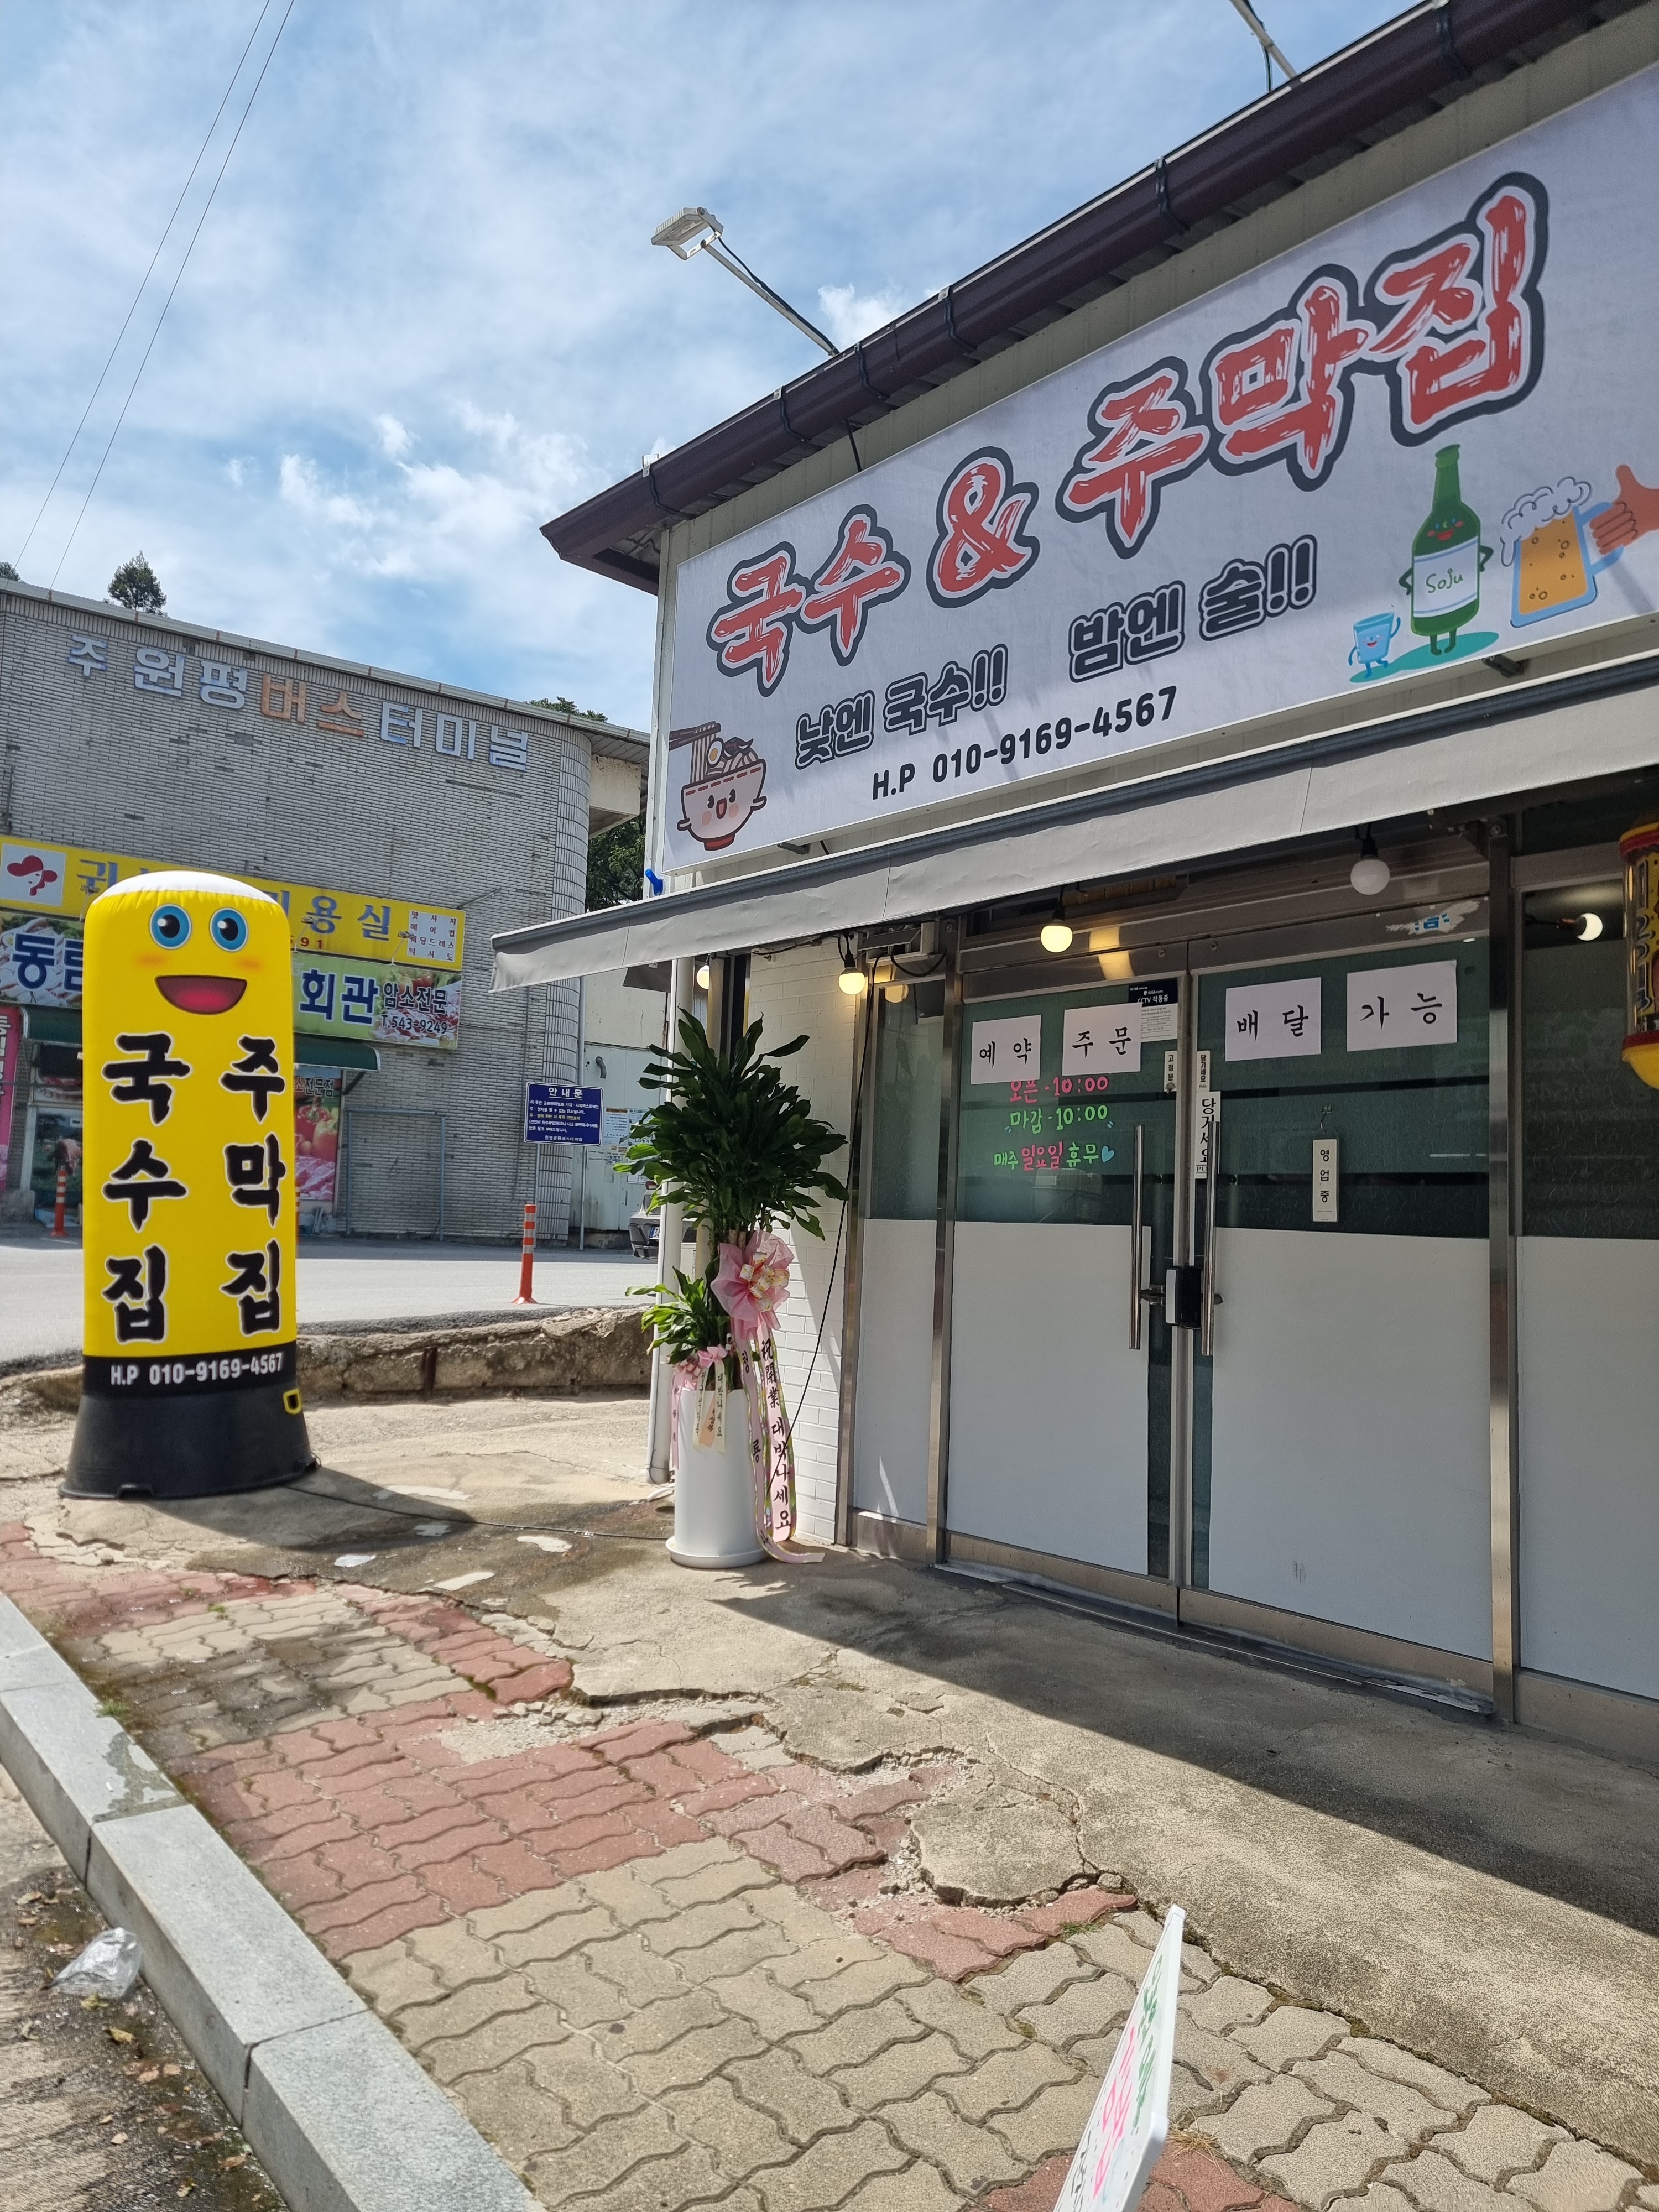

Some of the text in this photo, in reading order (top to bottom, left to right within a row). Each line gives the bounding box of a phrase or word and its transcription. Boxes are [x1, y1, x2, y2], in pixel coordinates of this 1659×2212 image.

[706, 171, 1548, 696] 국수 & 주막집
[1425, 567, 1464, 594] Soju
[795, 534, 1317, 769] 낮엔 국수!! 밤엔 술!!
[873, 686, 1177, 800] H.P 010-9169-4567
[299, 969, 379, 1025] 회관
[383, 982, 448, 1014] 암소전문
[1152, 994, 1168, 1003] 작동중
[1236, 992, 1443, 1041] 배달 가능
[978, 1026, 1131, 1066] 예약 주문
[294, 1077, 334, 1098] 소전문점
[548, 1087, 583, 1098] 안내문
[1010, 1108, 1043, 1134] 마감
[994, 1141, 1099, 1171] 매주 일요일 휴무
[111, 1352, 283, 1385] H.P 010-9169-4567
[771, 1416, 791, 1530] 대박나세요
